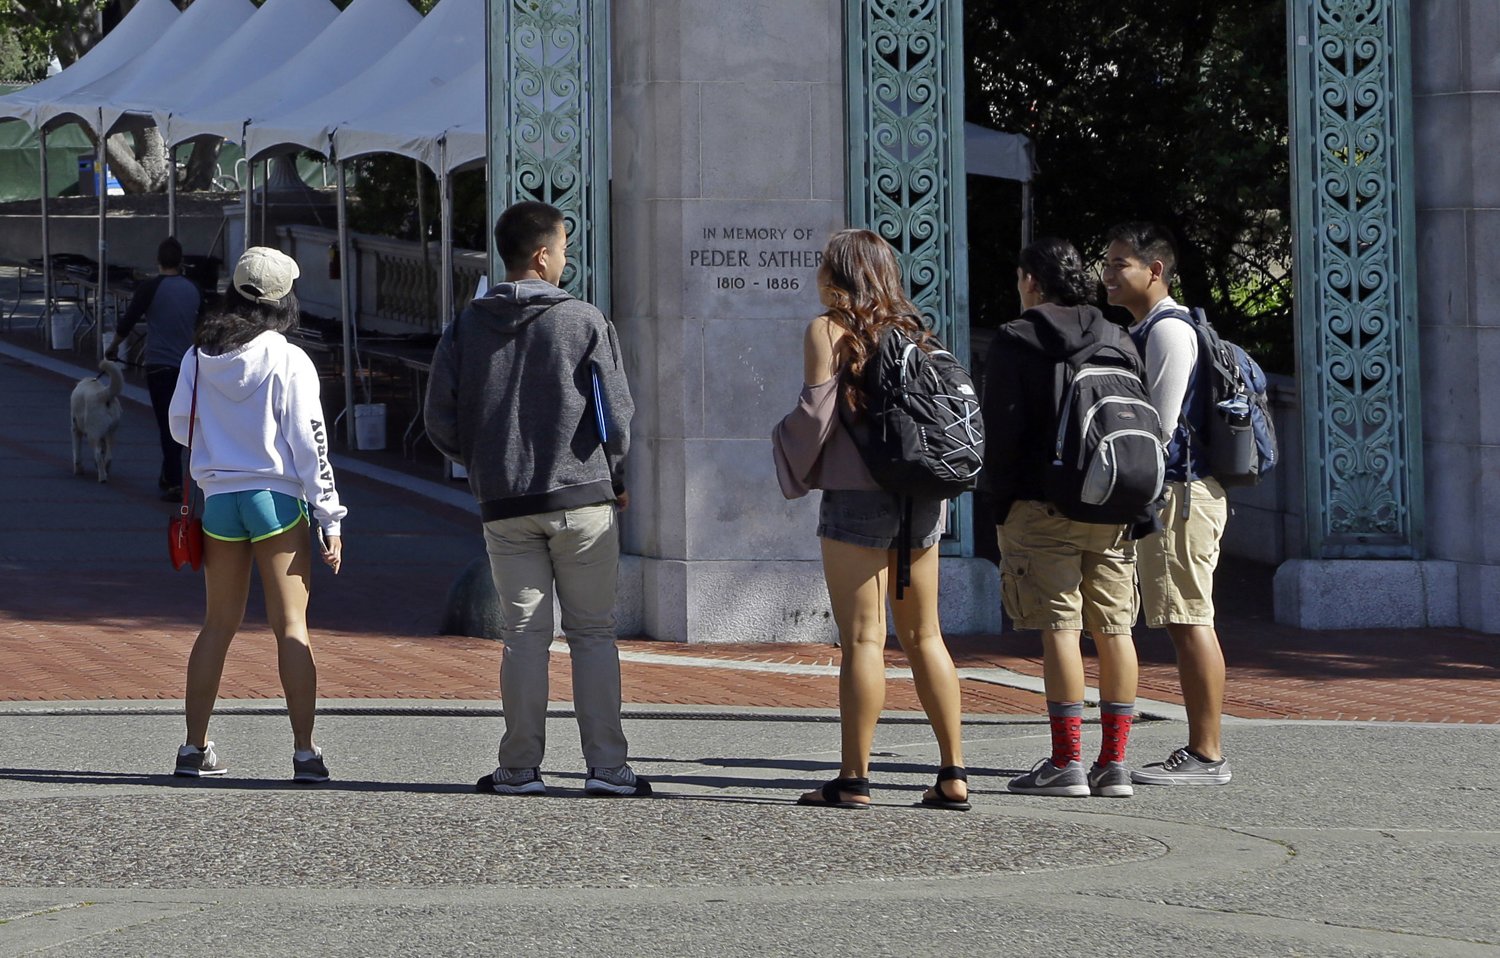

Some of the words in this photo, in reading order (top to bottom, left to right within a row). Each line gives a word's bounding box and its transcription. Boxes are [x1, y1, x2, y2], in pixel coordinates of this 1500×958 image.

[702, 228, 717, 240] IN
[722, 228, 788, 241] MEMORY
[793, 228, 816, 241] OF
[690, 250, 751, 267] PEDER
[758, 250, 825, 268] SATHER
[717, 277, 746, 290] 1810
[766, 277, 800, 291] 1886
